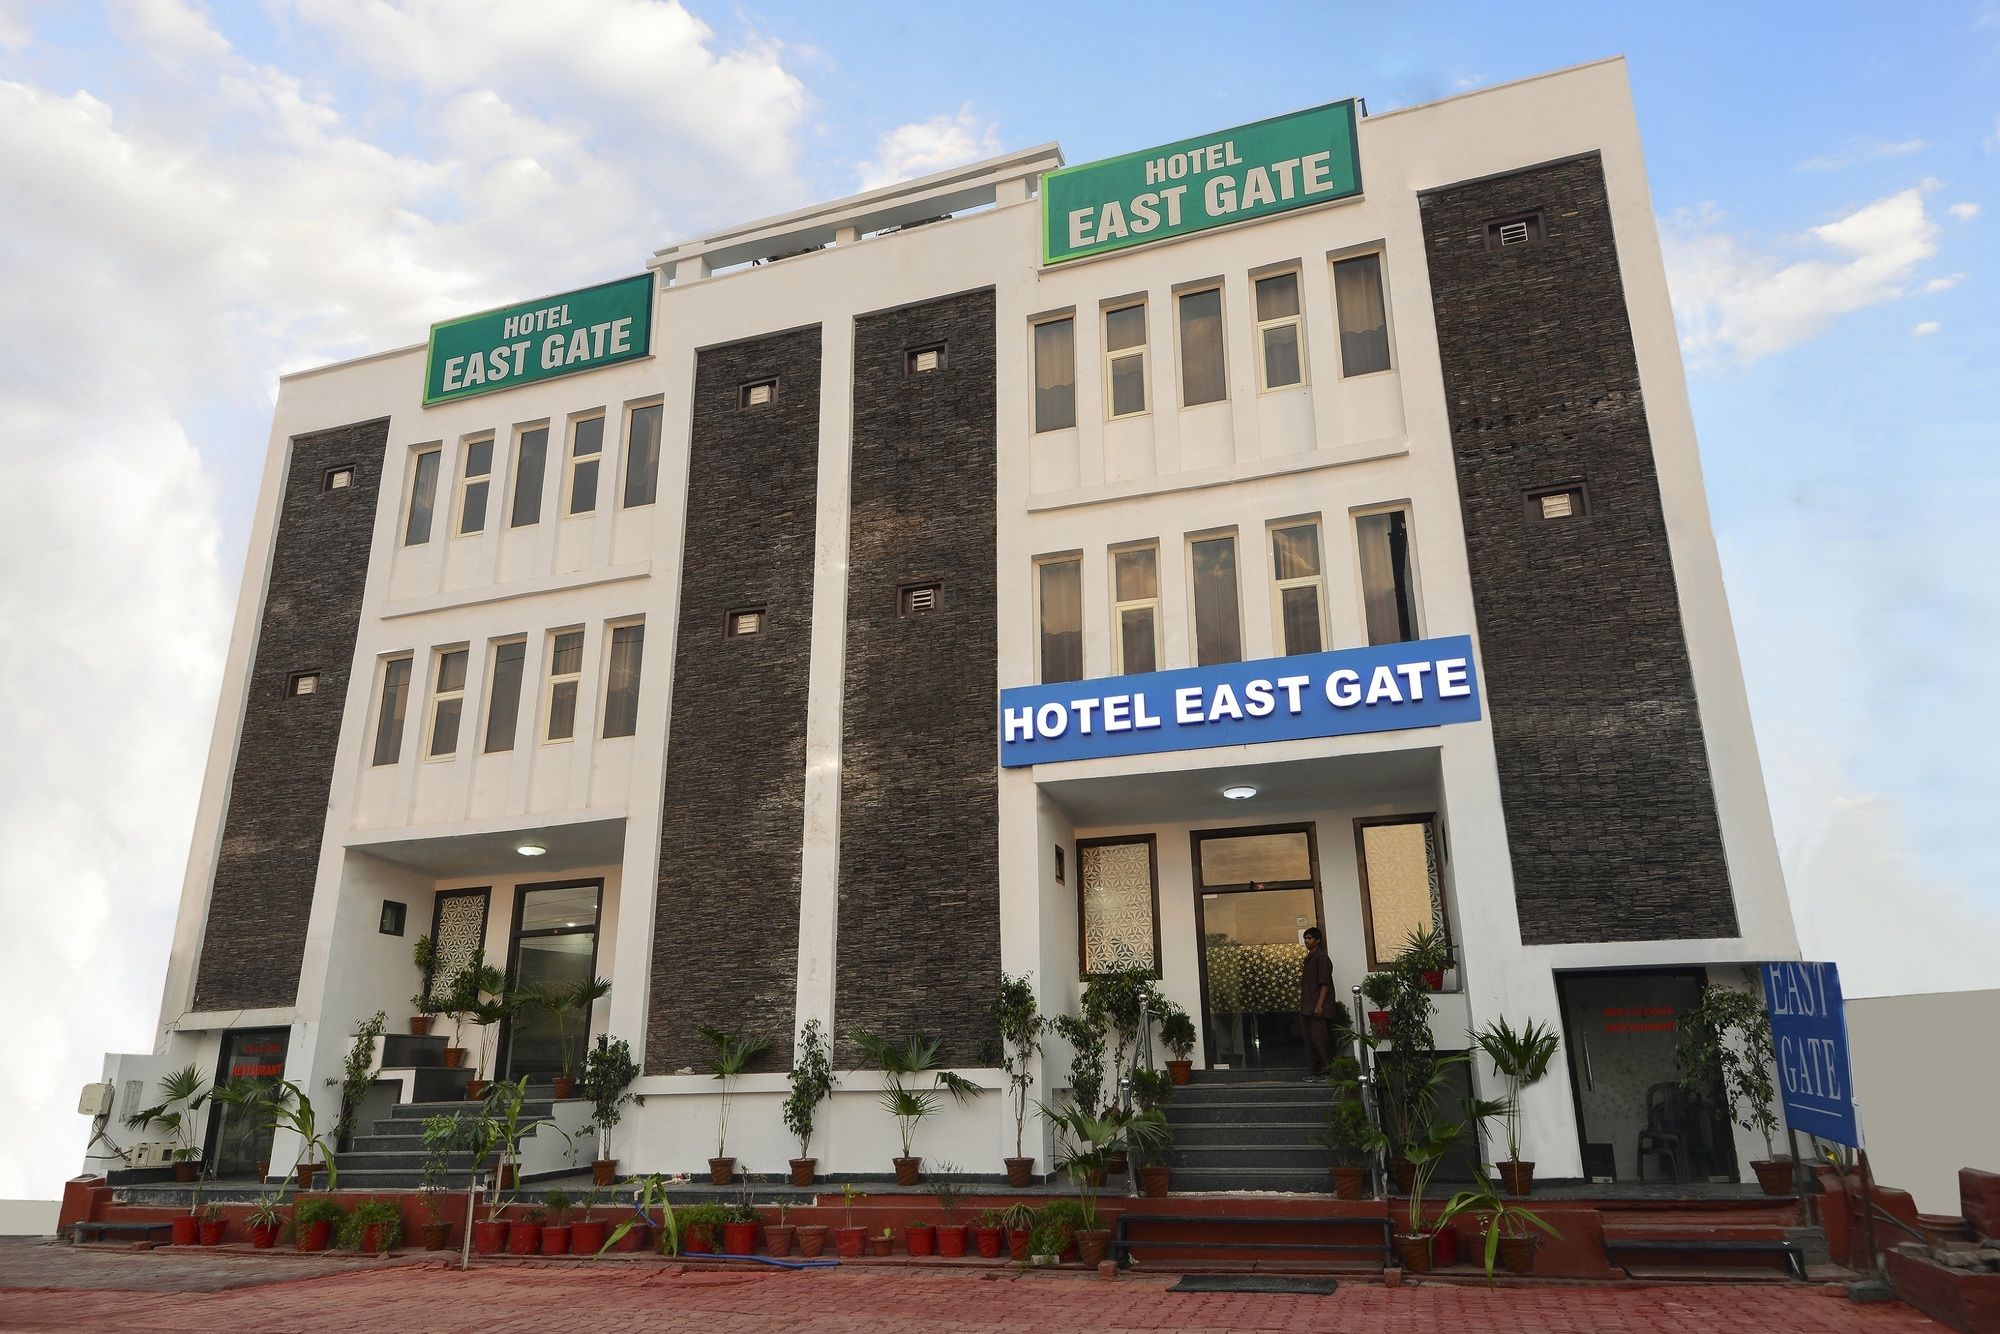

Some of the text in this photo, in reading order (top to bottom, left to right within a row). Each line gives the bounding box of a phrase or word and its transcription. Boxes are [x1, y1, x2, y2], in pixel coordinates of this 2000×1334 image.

[1145, 140, 1243, 186] HOTEL
[1068, 150, 1334, 249] EAST GATE
[503, 304, 573, 340] HOTEL
[442, 316, 633, 393] EAST GATE
[1004, 657, 1471, 743] HOTEL EAST GATE
[1768, 962, 1828, 1016] EAST
[231, 1063, 283, 1077] RESTAURANT
[1780, 1035, 1842, 1101] GATE
